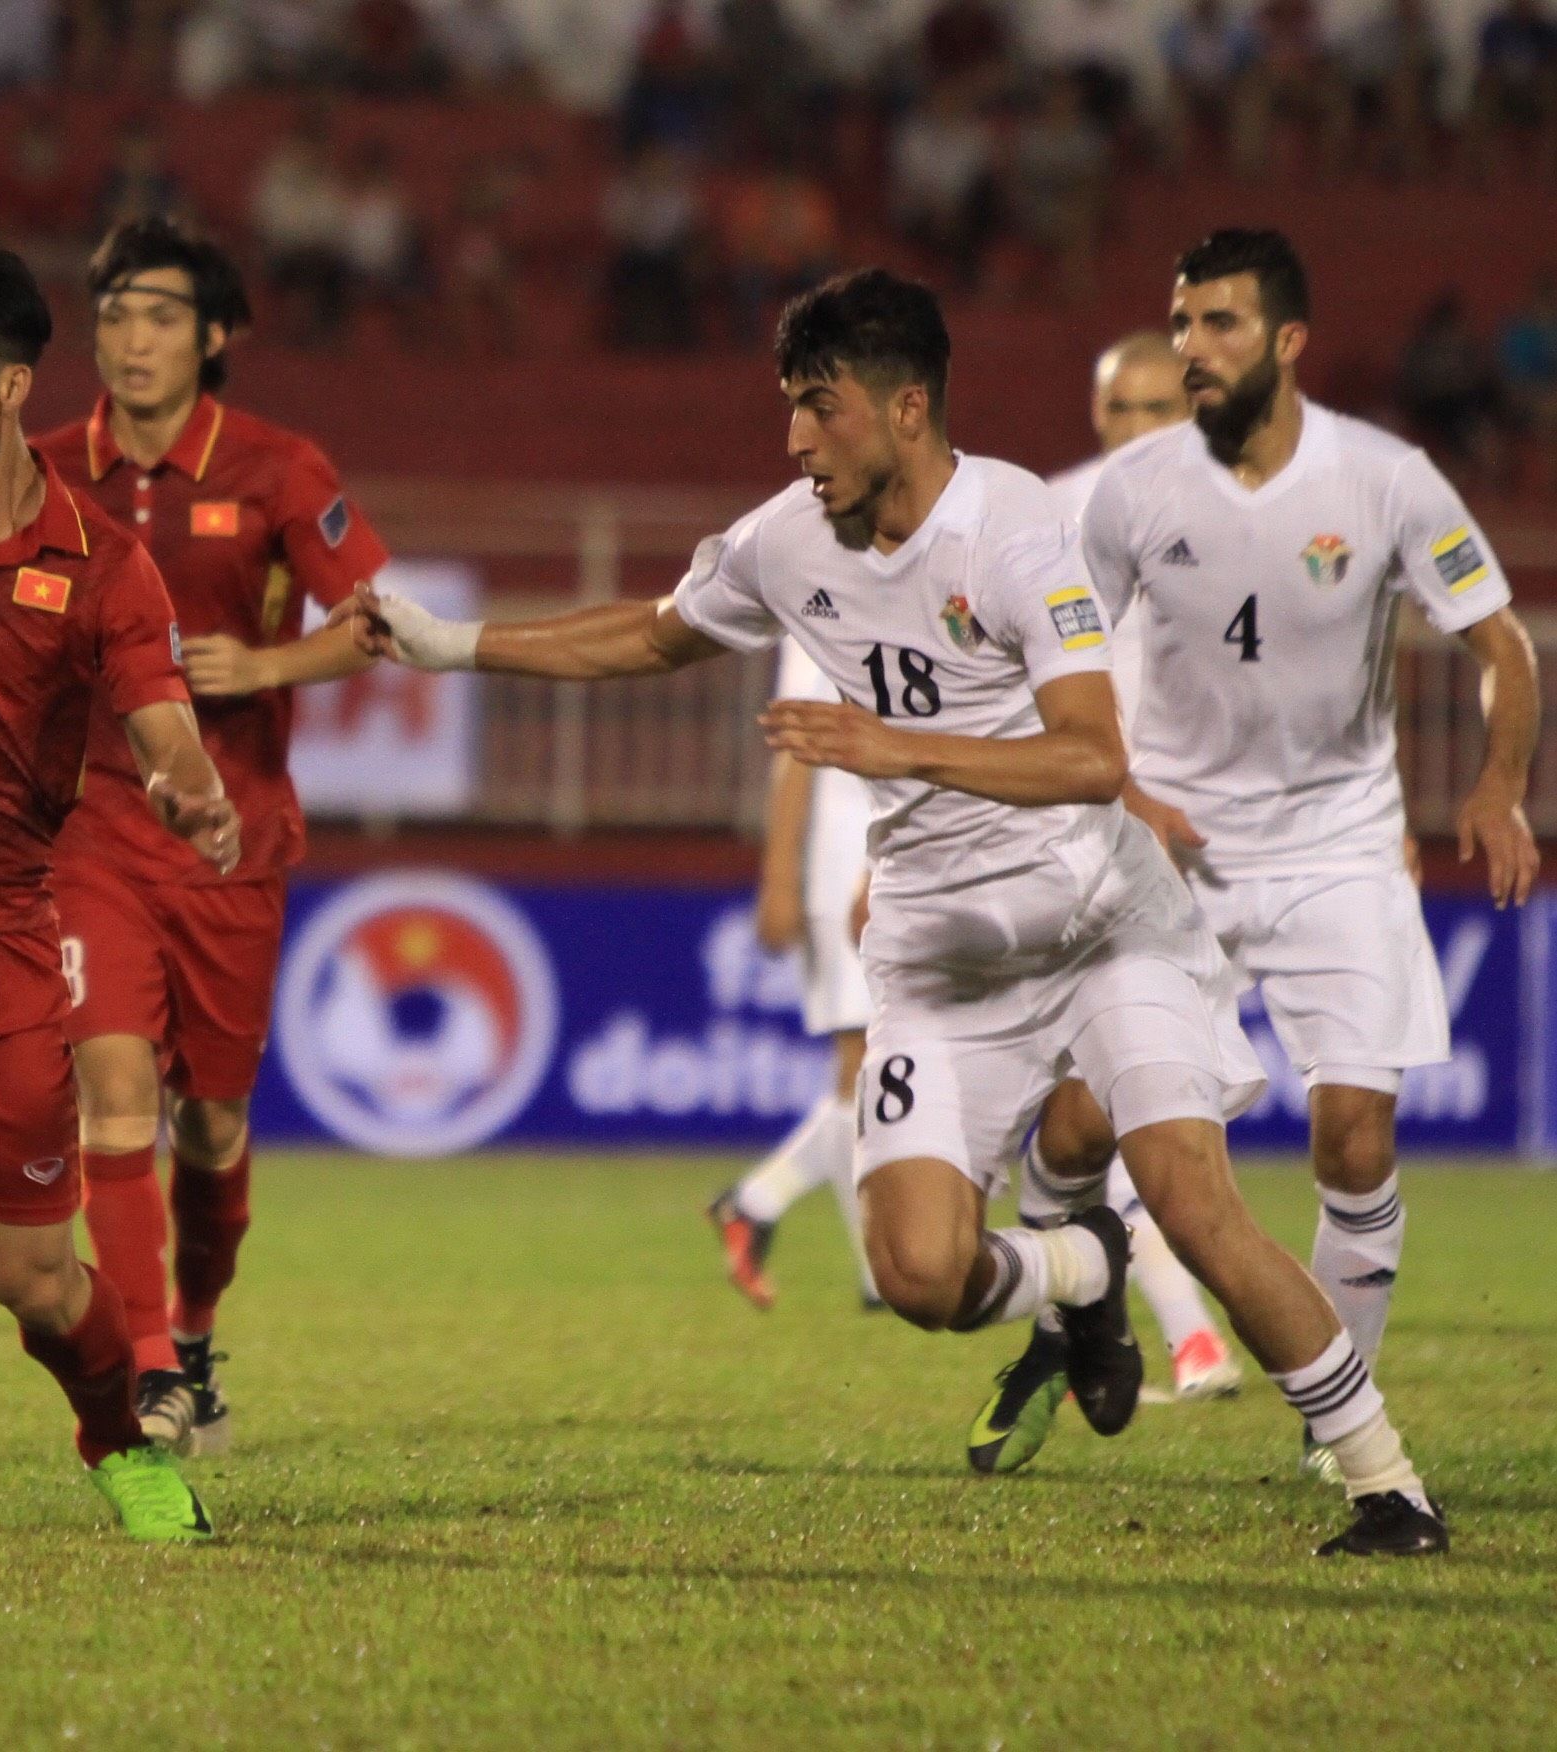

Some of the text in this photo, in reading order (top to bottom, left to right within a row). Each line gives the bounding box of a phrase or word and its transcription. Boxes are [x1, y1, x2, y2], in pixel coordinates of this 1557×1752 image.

[801, 605, 840, 620] adidas
[1224, 592, 1263, 662] 4
[862, 642, 942, 717] 18
